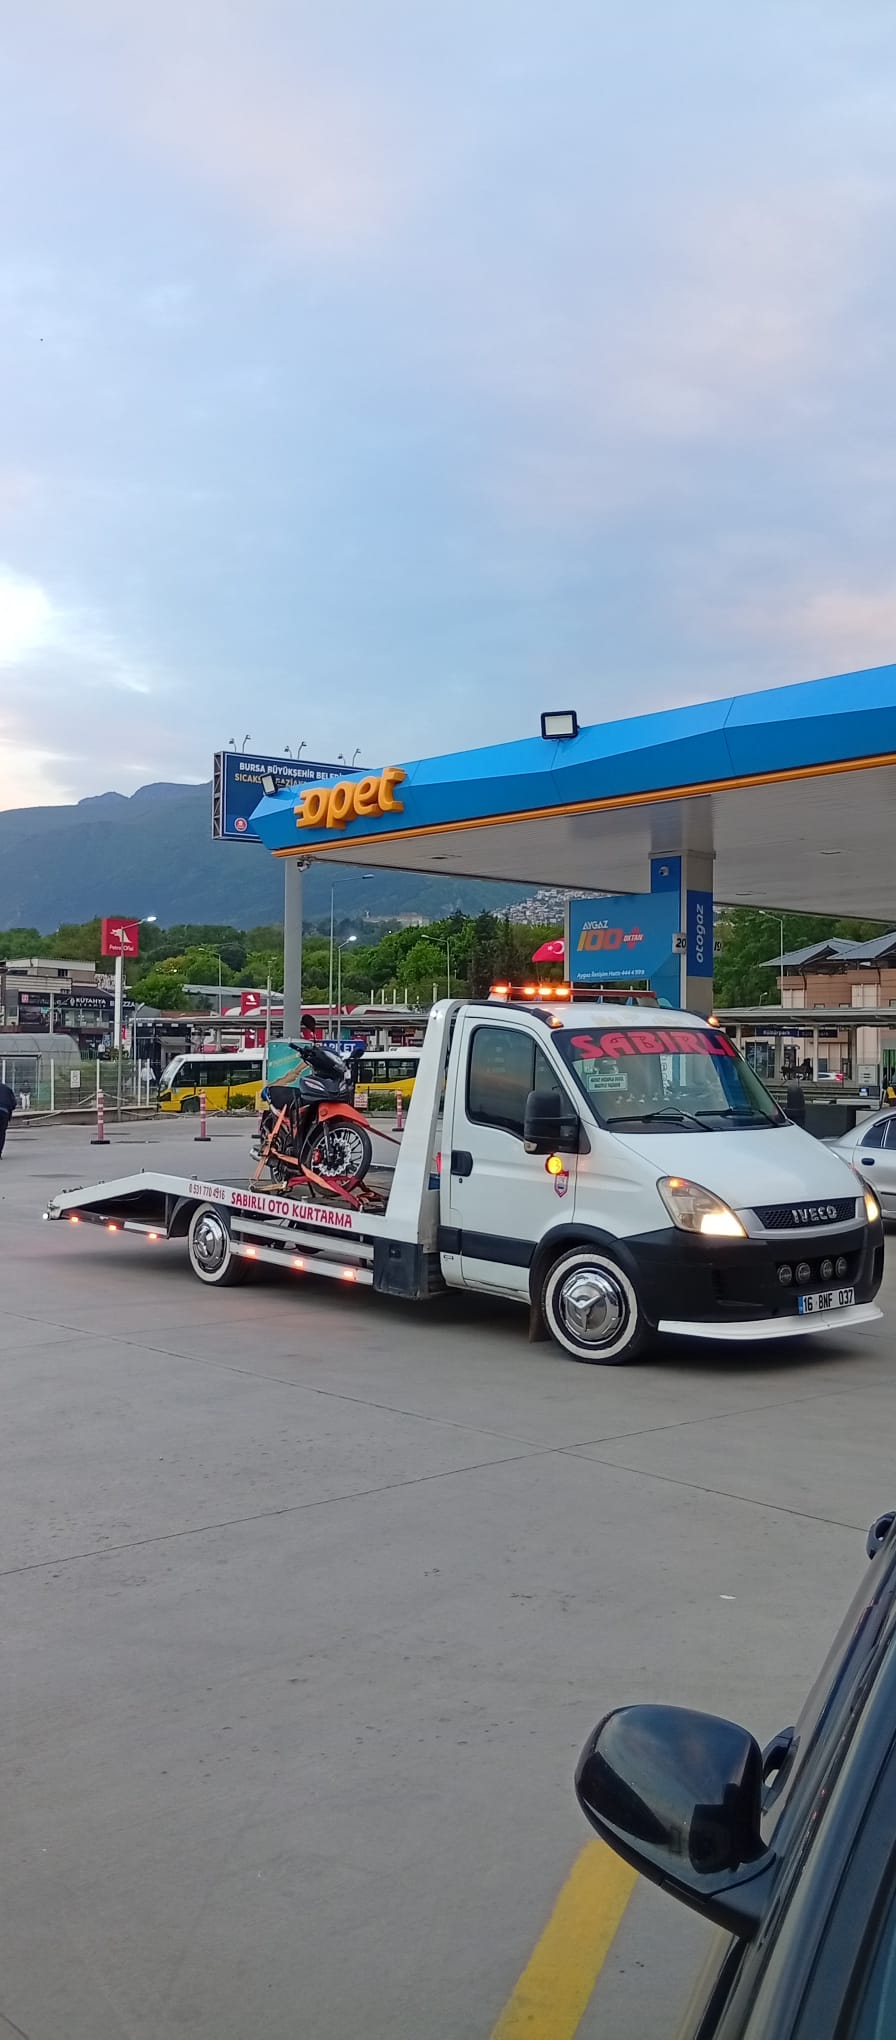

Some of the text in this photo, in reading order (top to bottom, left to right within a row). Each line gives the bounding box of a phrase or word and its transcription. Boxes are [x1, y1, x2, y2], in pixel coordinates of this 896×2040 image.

[239, 762, 266, 773] BURSA
[267, 764, 315, 778] BÜYÜKŞEHİR
[293, 766, 407, 831] opet
[582, 920, 609, 930] AYGAZ
[695, 903, 706, 964] otogaz
[675, 937, 687, 948] 20
[570, 1031, 736, 1059] SABIRLI
[193, 1184, 202, 1195] 531
[203, 1186, 212, 1197] 770
[231, 1191, 265, 1211] SABIRLI
[268, 1199, 289, 1215] OTO
[292, 1203, 353, 1228] KURTARMA
[791, 1205, 837, 1223] IVECO
[803, 1288, 853, 1312] 16 BNF 037
